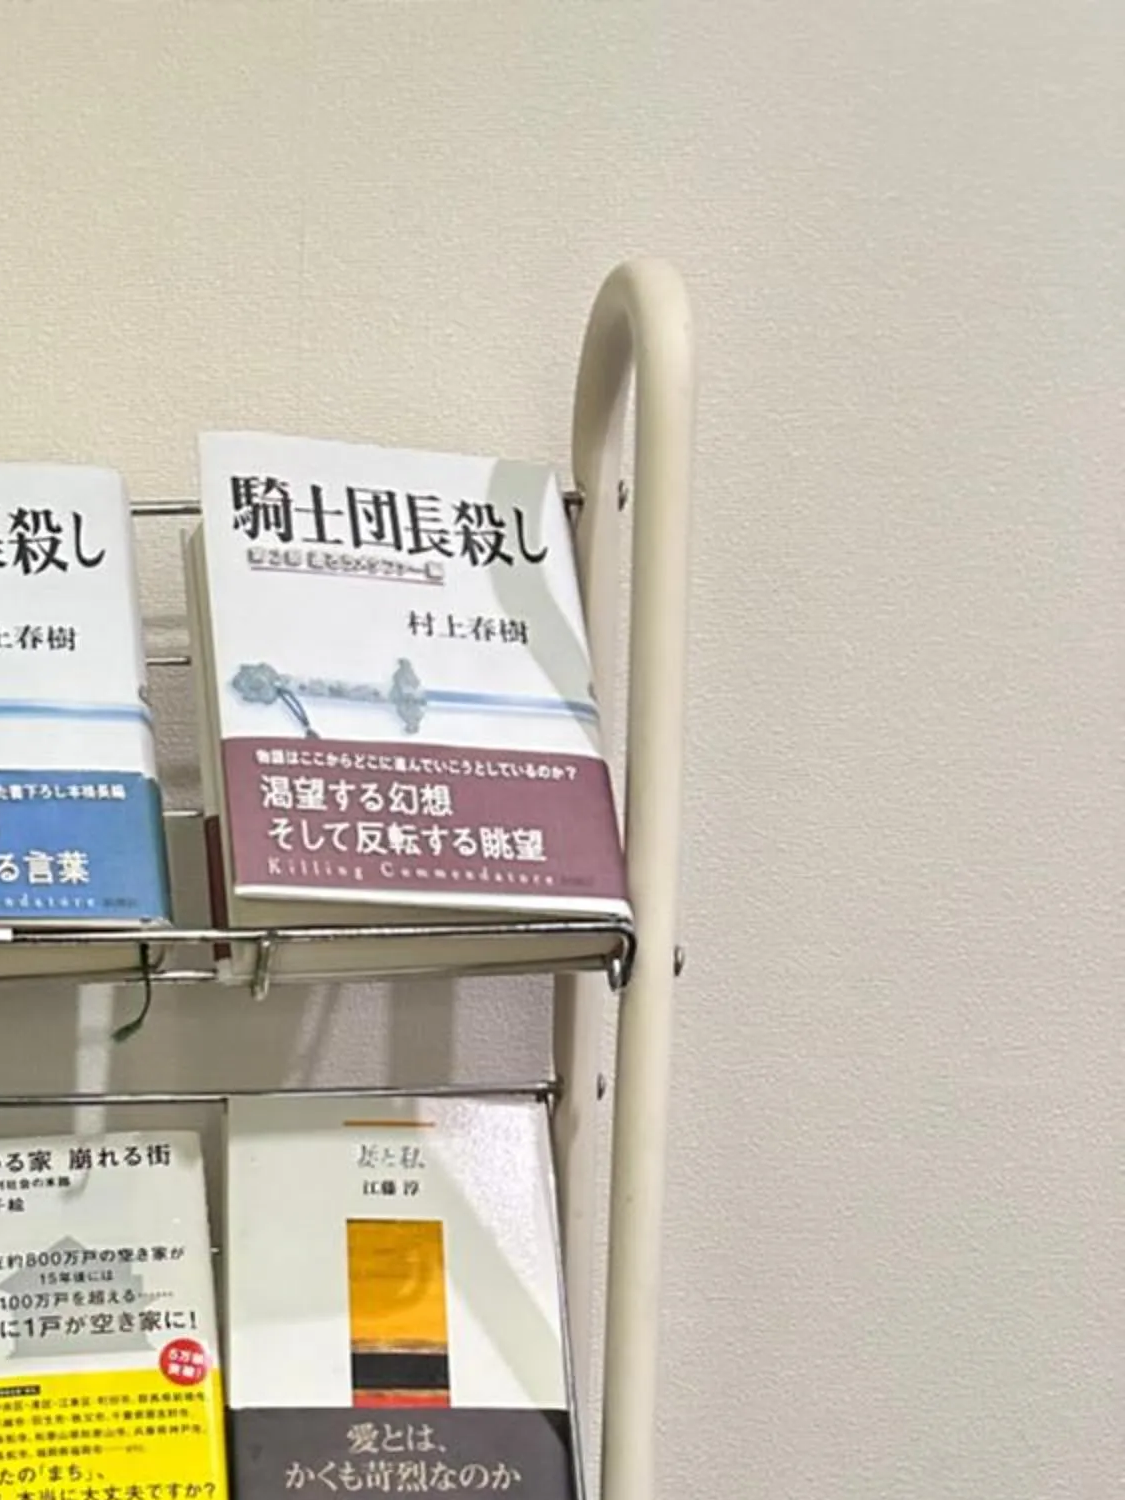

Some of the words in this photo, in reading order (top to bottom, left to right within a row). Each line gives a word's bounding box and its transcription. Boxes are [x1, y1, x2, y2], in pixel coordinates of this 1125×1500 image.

[230, 475, 548, 568] 騎士団長殺し
[408, 611, 529, 645] 村上春樹
[260, 775, 453, 817] 渇望する幻想
[269, 818, 547, 861] そして反転する眺望
[68, 1144, 171, 1171] 崩れる街
[347, 1423, 447, 1455] 愛とは、
[285, 1462, 522, 1493] かくも苛烈なのか
